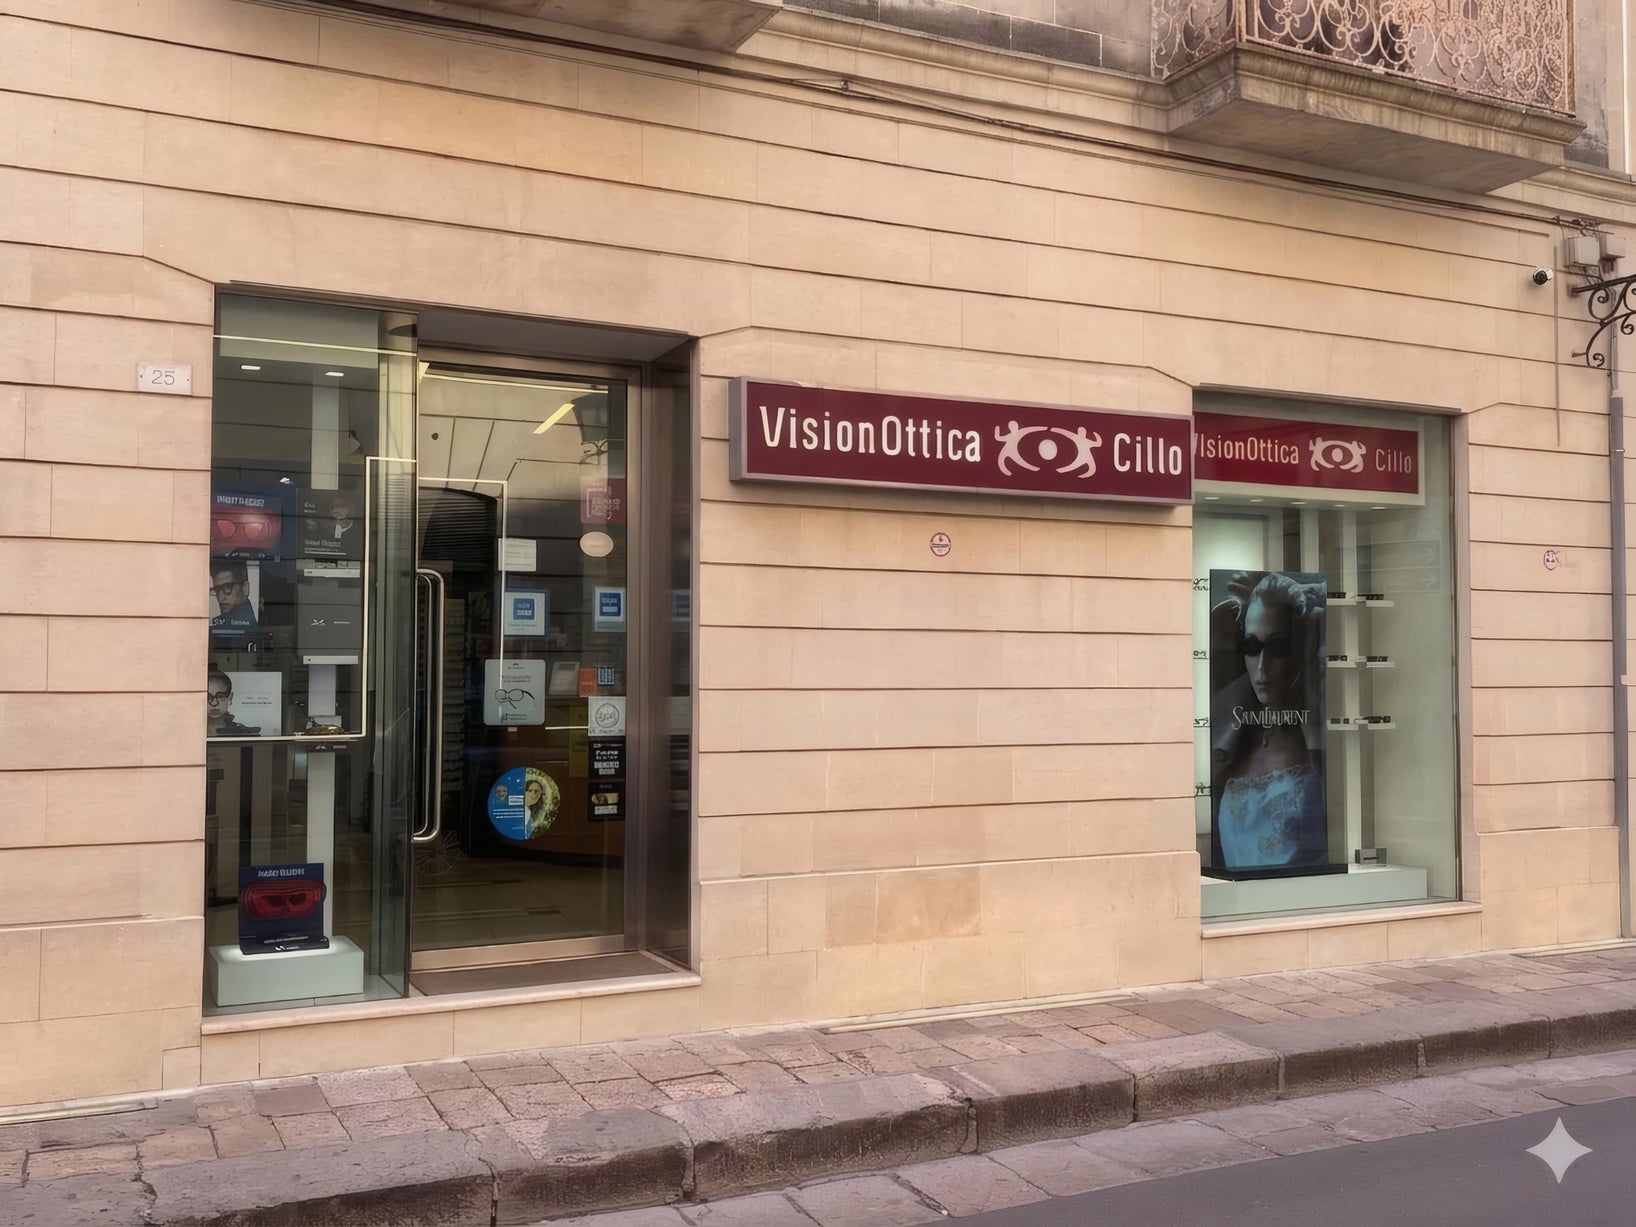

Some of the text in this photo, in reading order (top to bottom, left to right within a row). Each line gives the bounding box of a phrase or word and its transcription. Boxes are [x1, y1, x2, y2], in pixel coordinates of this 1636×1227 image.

[151, 369, 175, 386] 25
[759, 405, 1182, 476] VisionOttica Cillo
[1375, 448, 1412, 474] Cillo
